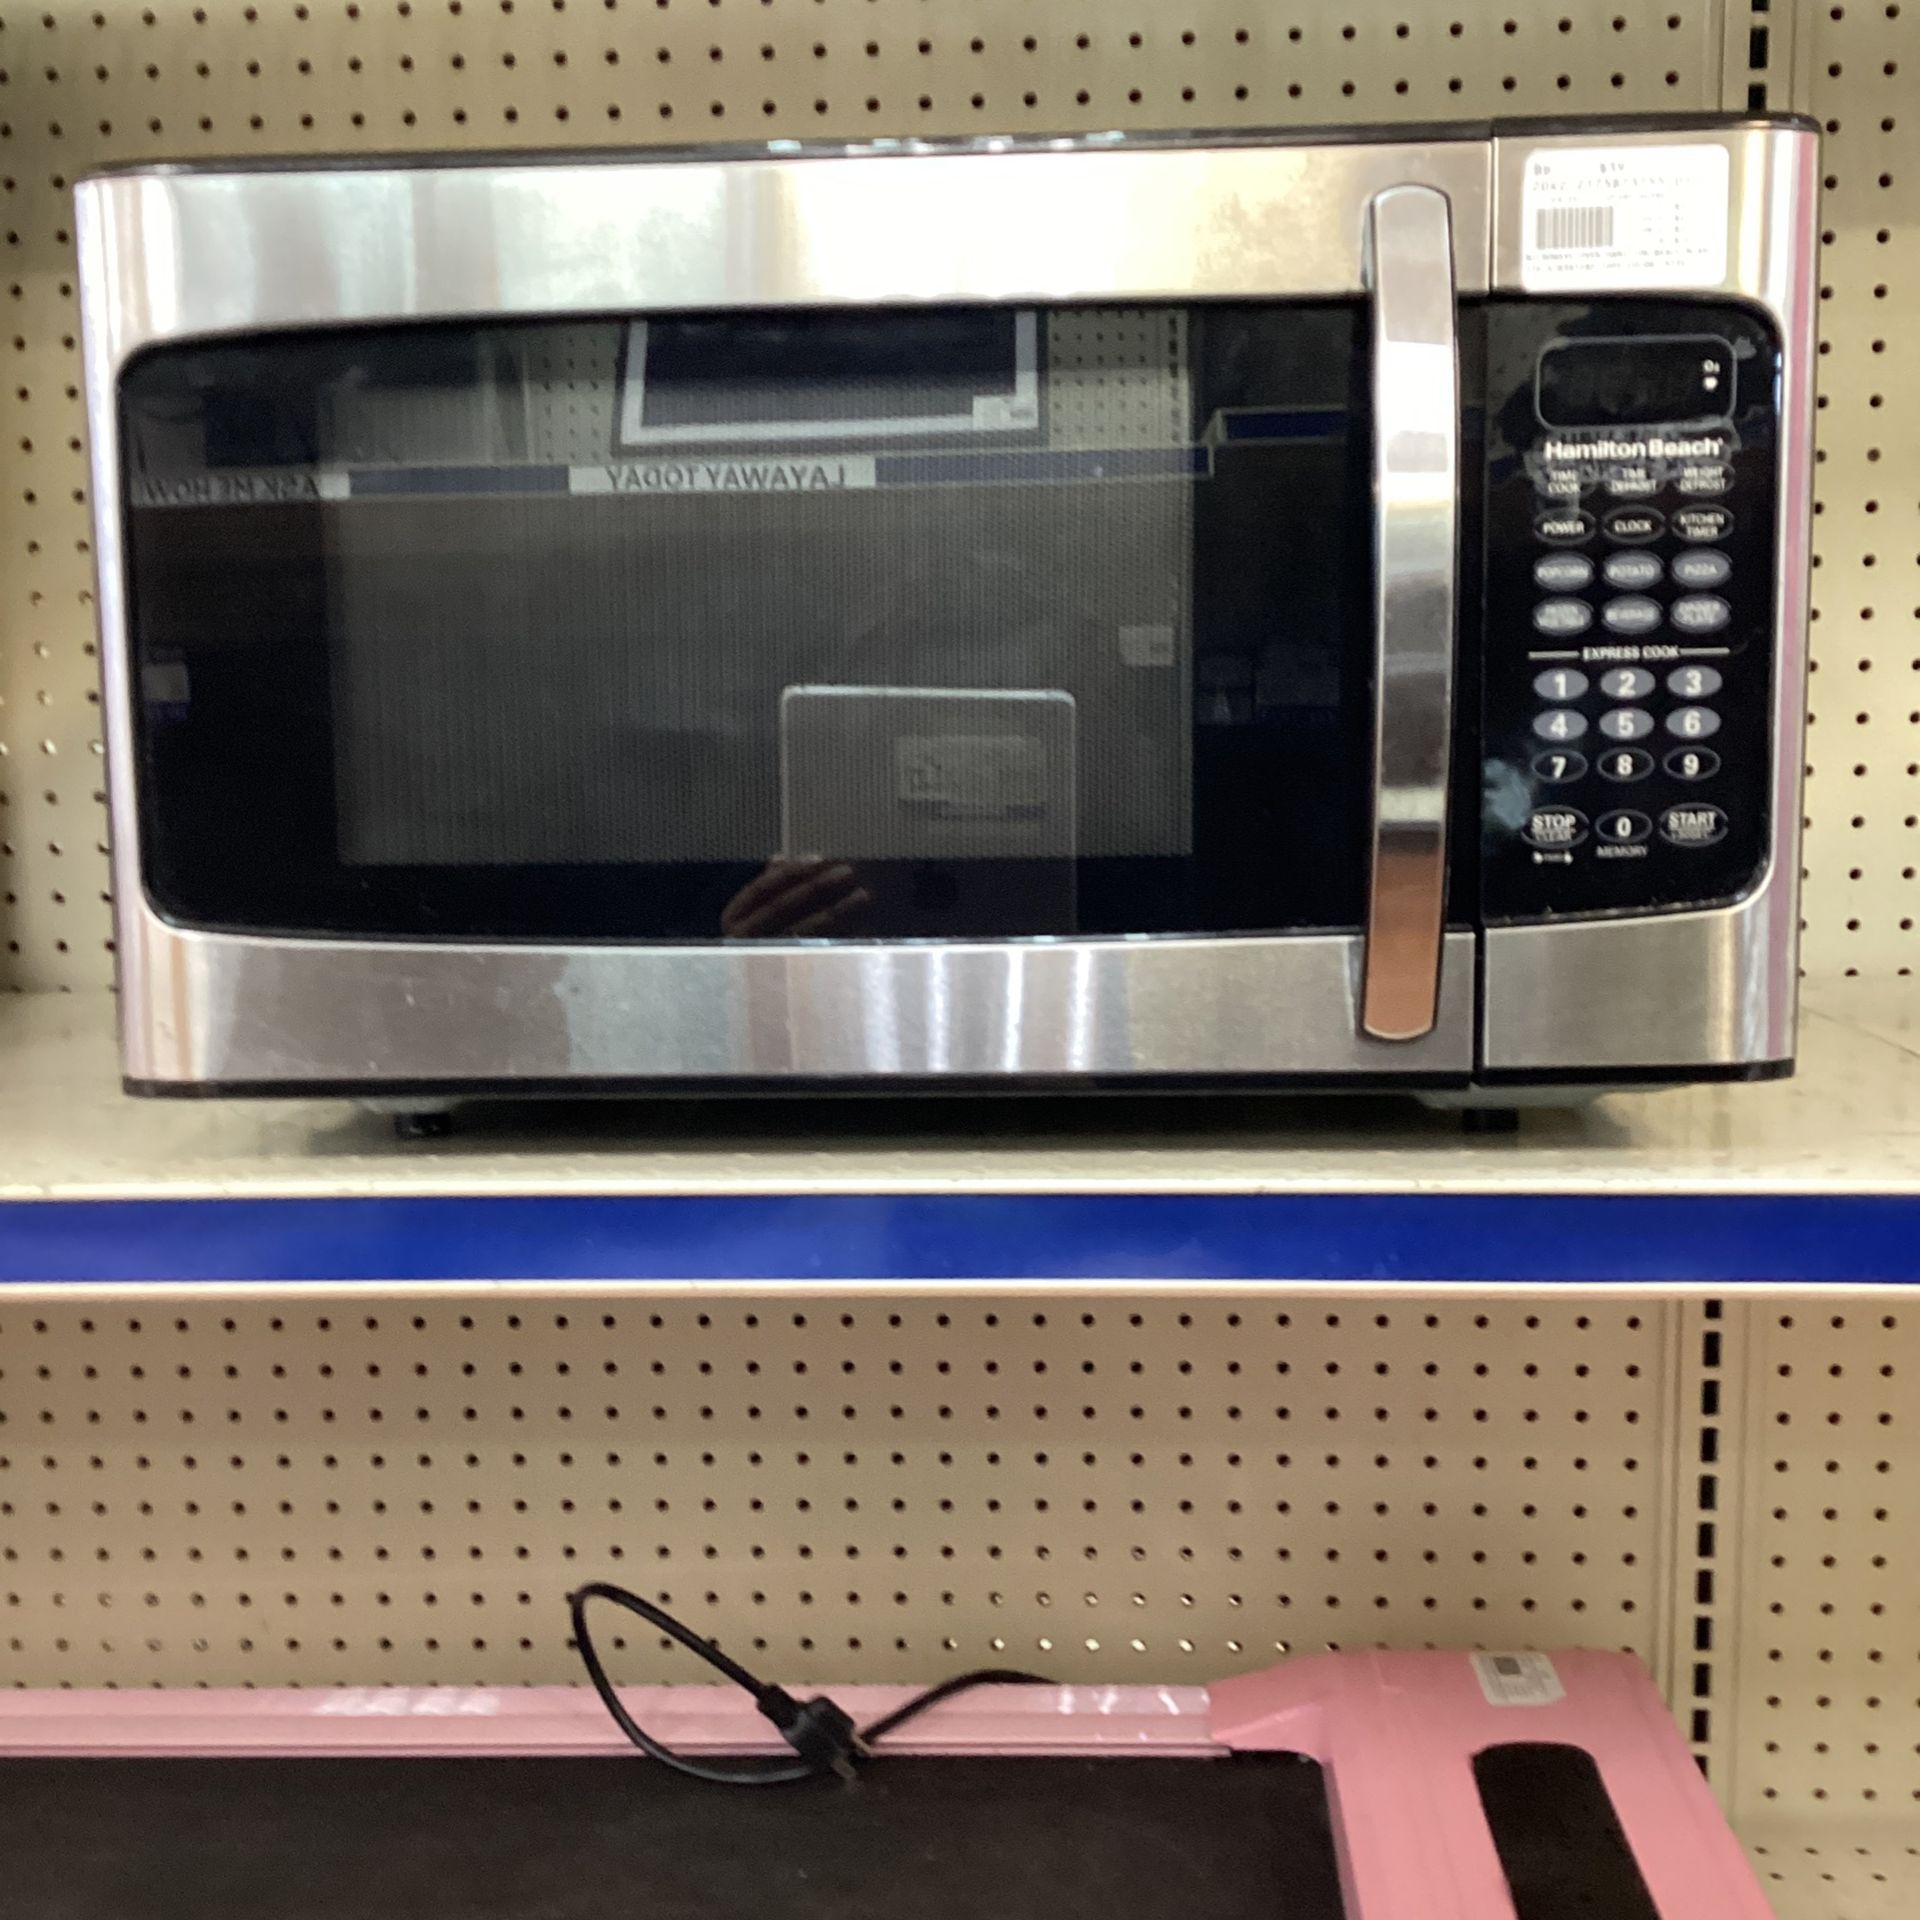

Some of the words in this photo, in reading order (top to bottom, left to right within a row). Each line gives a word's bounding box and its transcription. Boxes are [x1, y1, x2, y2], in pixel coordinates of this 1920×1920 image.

[1544, 440, 1646, 459] Hamilton
[1648, 438, 1720, 457] Beach
[1542, 521, 1585, 535] POWER
[1614, 519, 1651, 533] CLOCK
[1680, 513, 1725, 526] KITCHEN
[1687, 525, 1718, 538] TIMER
[1583, 647, 1640, 662] EXPRESS
[1642, 645, 1680, 659] COOK
[1554, 673, 1567, 698] 1
[1618, 670, 1635, 696] 2
[1685, 669, 1702, 695] 3
[1550, 713, 1567, 738] 4
[1617, 711, 1634, 736] 5
[1684, 710, 1701, 734] 6
[1551, 755, 1567, 779] 7
[1617, 753, 1633, 776] 8
[1682, 753, 1699, 776] 9
[1532, 814, 1576, 830] STOP
[1616, 816, 1631, 838] 0
[1668, 811, 1715, 828] START
[1597, 845, 1648, 858] MEMORY
